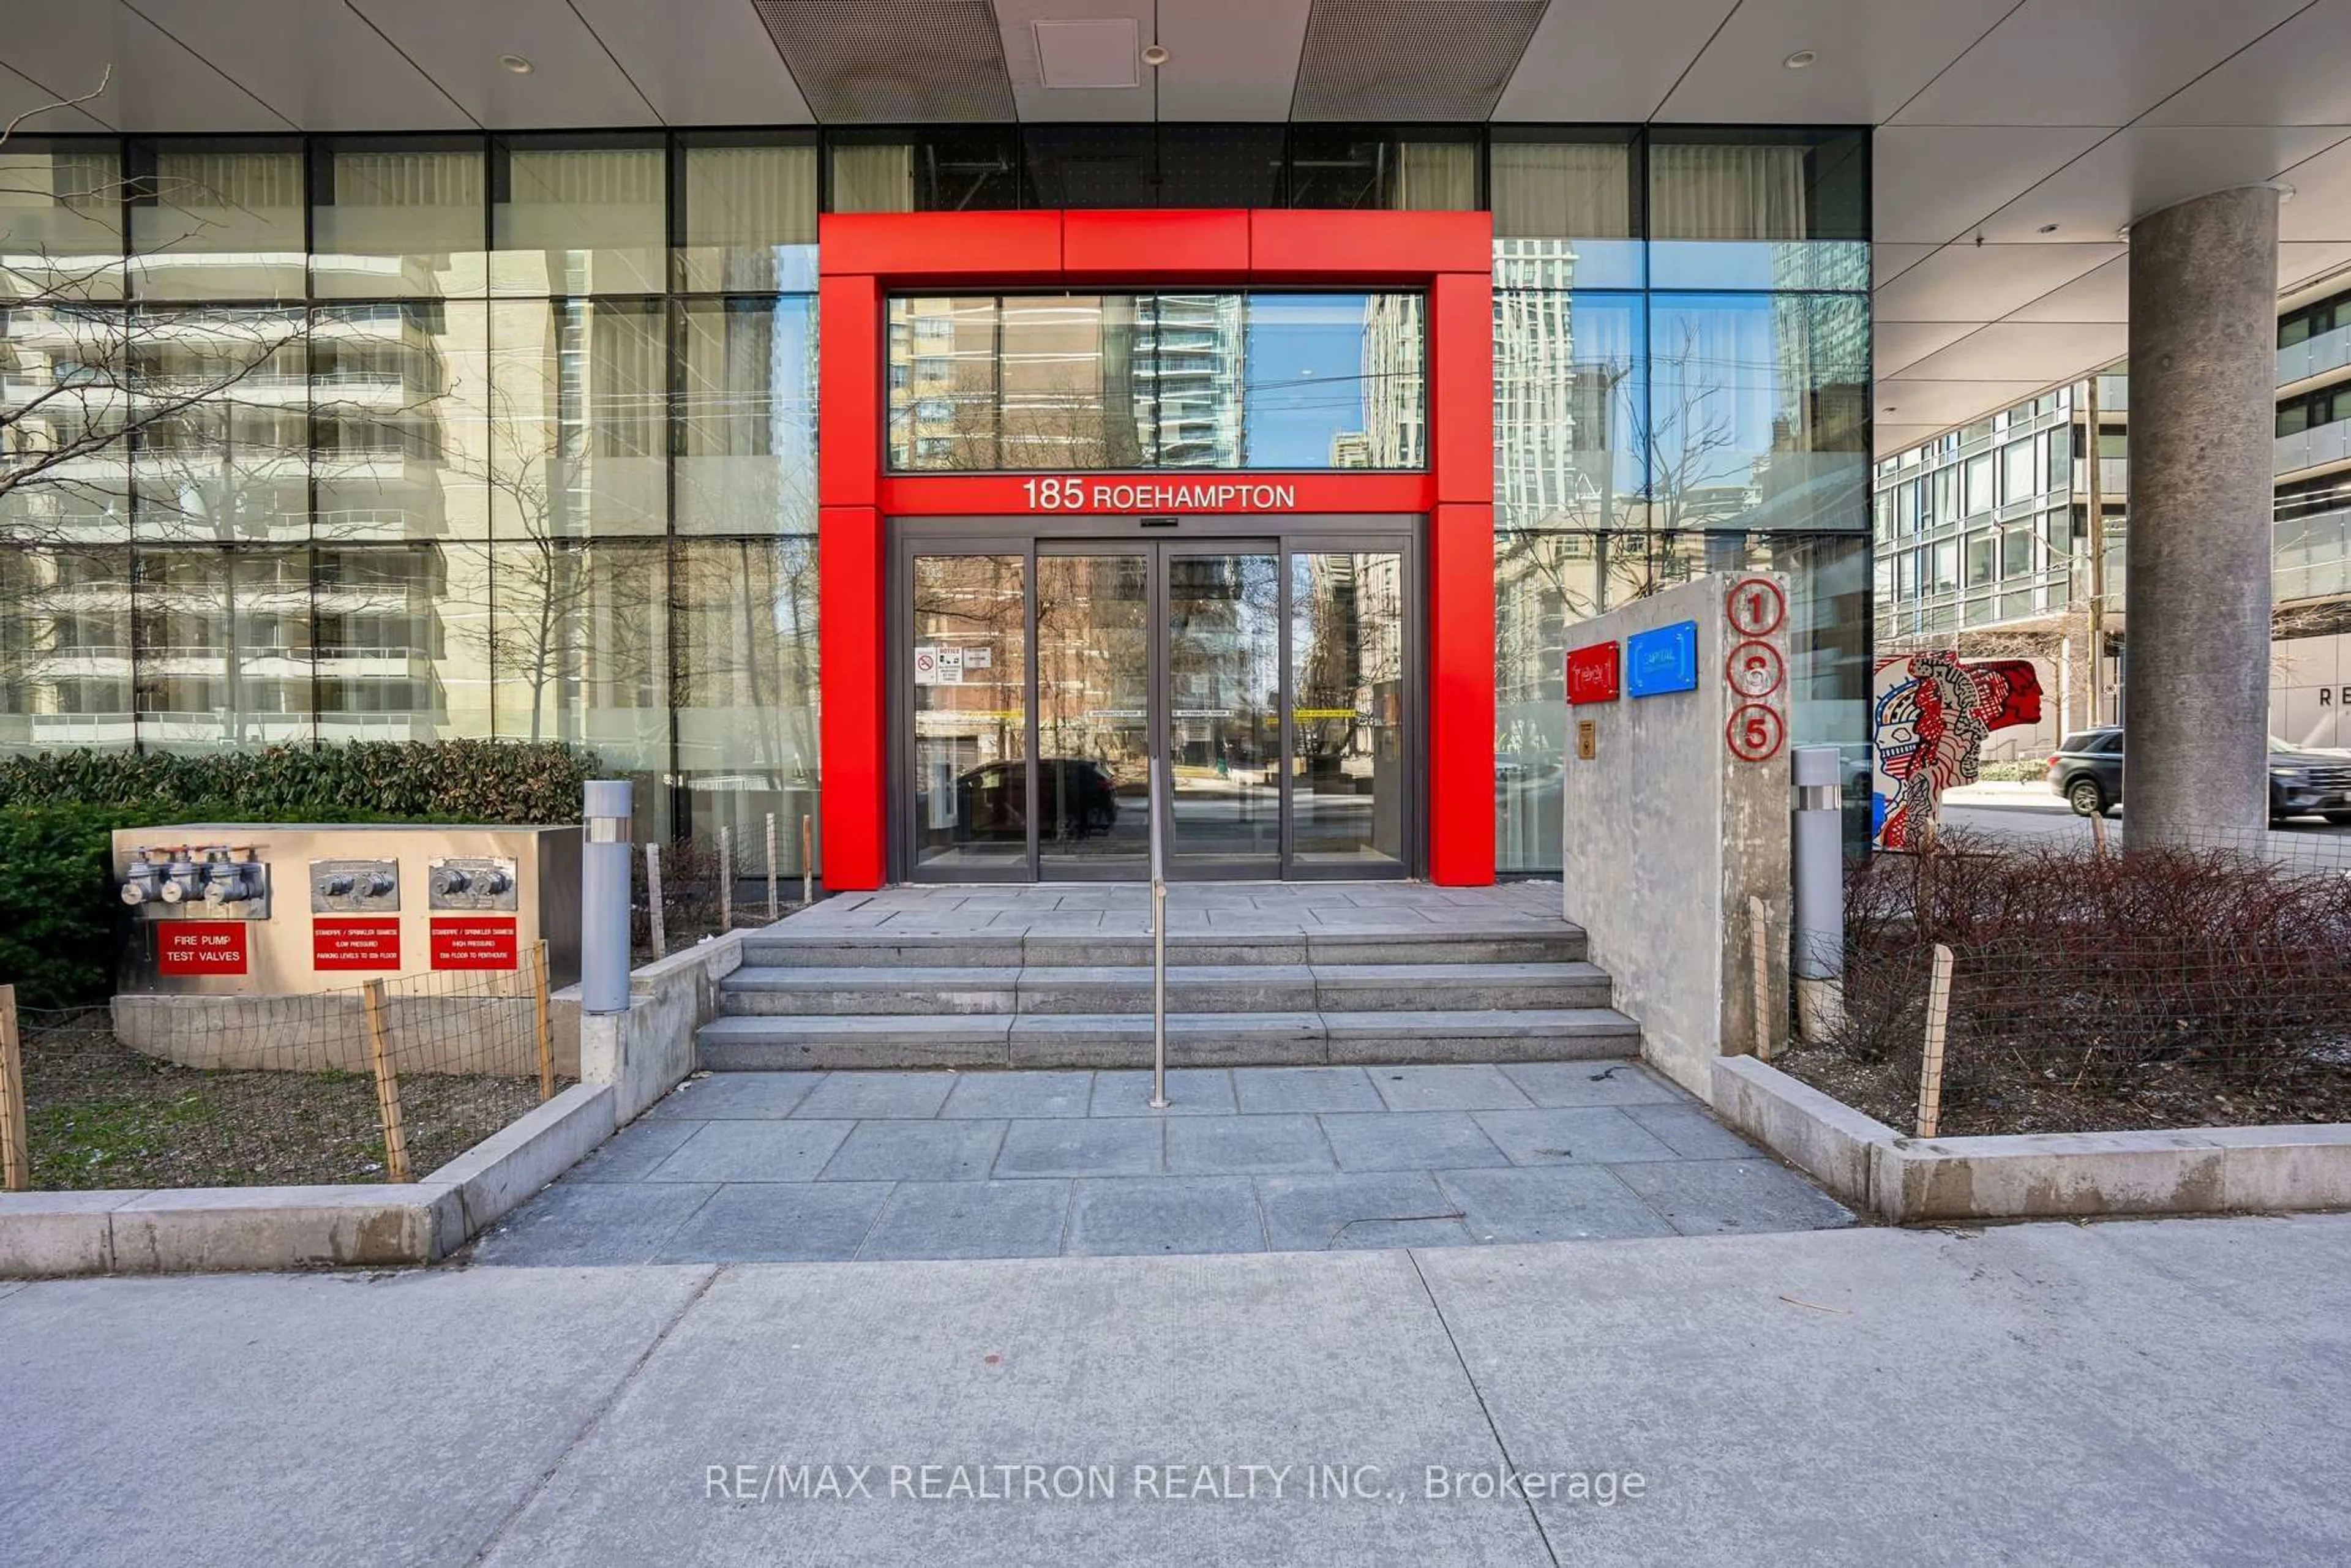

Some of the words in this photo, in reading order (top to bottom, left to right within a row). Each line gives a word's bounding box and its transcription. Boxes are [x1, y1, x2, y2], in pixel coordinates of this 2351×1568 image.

[1023, 479, 1084, 509] 185
[1093, 486, 1295, 508] ROEHAMPTON
[1747, 593, 1762, 623] 1
[1745, 718, 1767, 749] 5
[174, 936, 197, 945] FIRE
[201, 936, 231, 945] PUMP
[167, 951, 195, 961] TEST
[199, 951, 240, 961] VALVES
